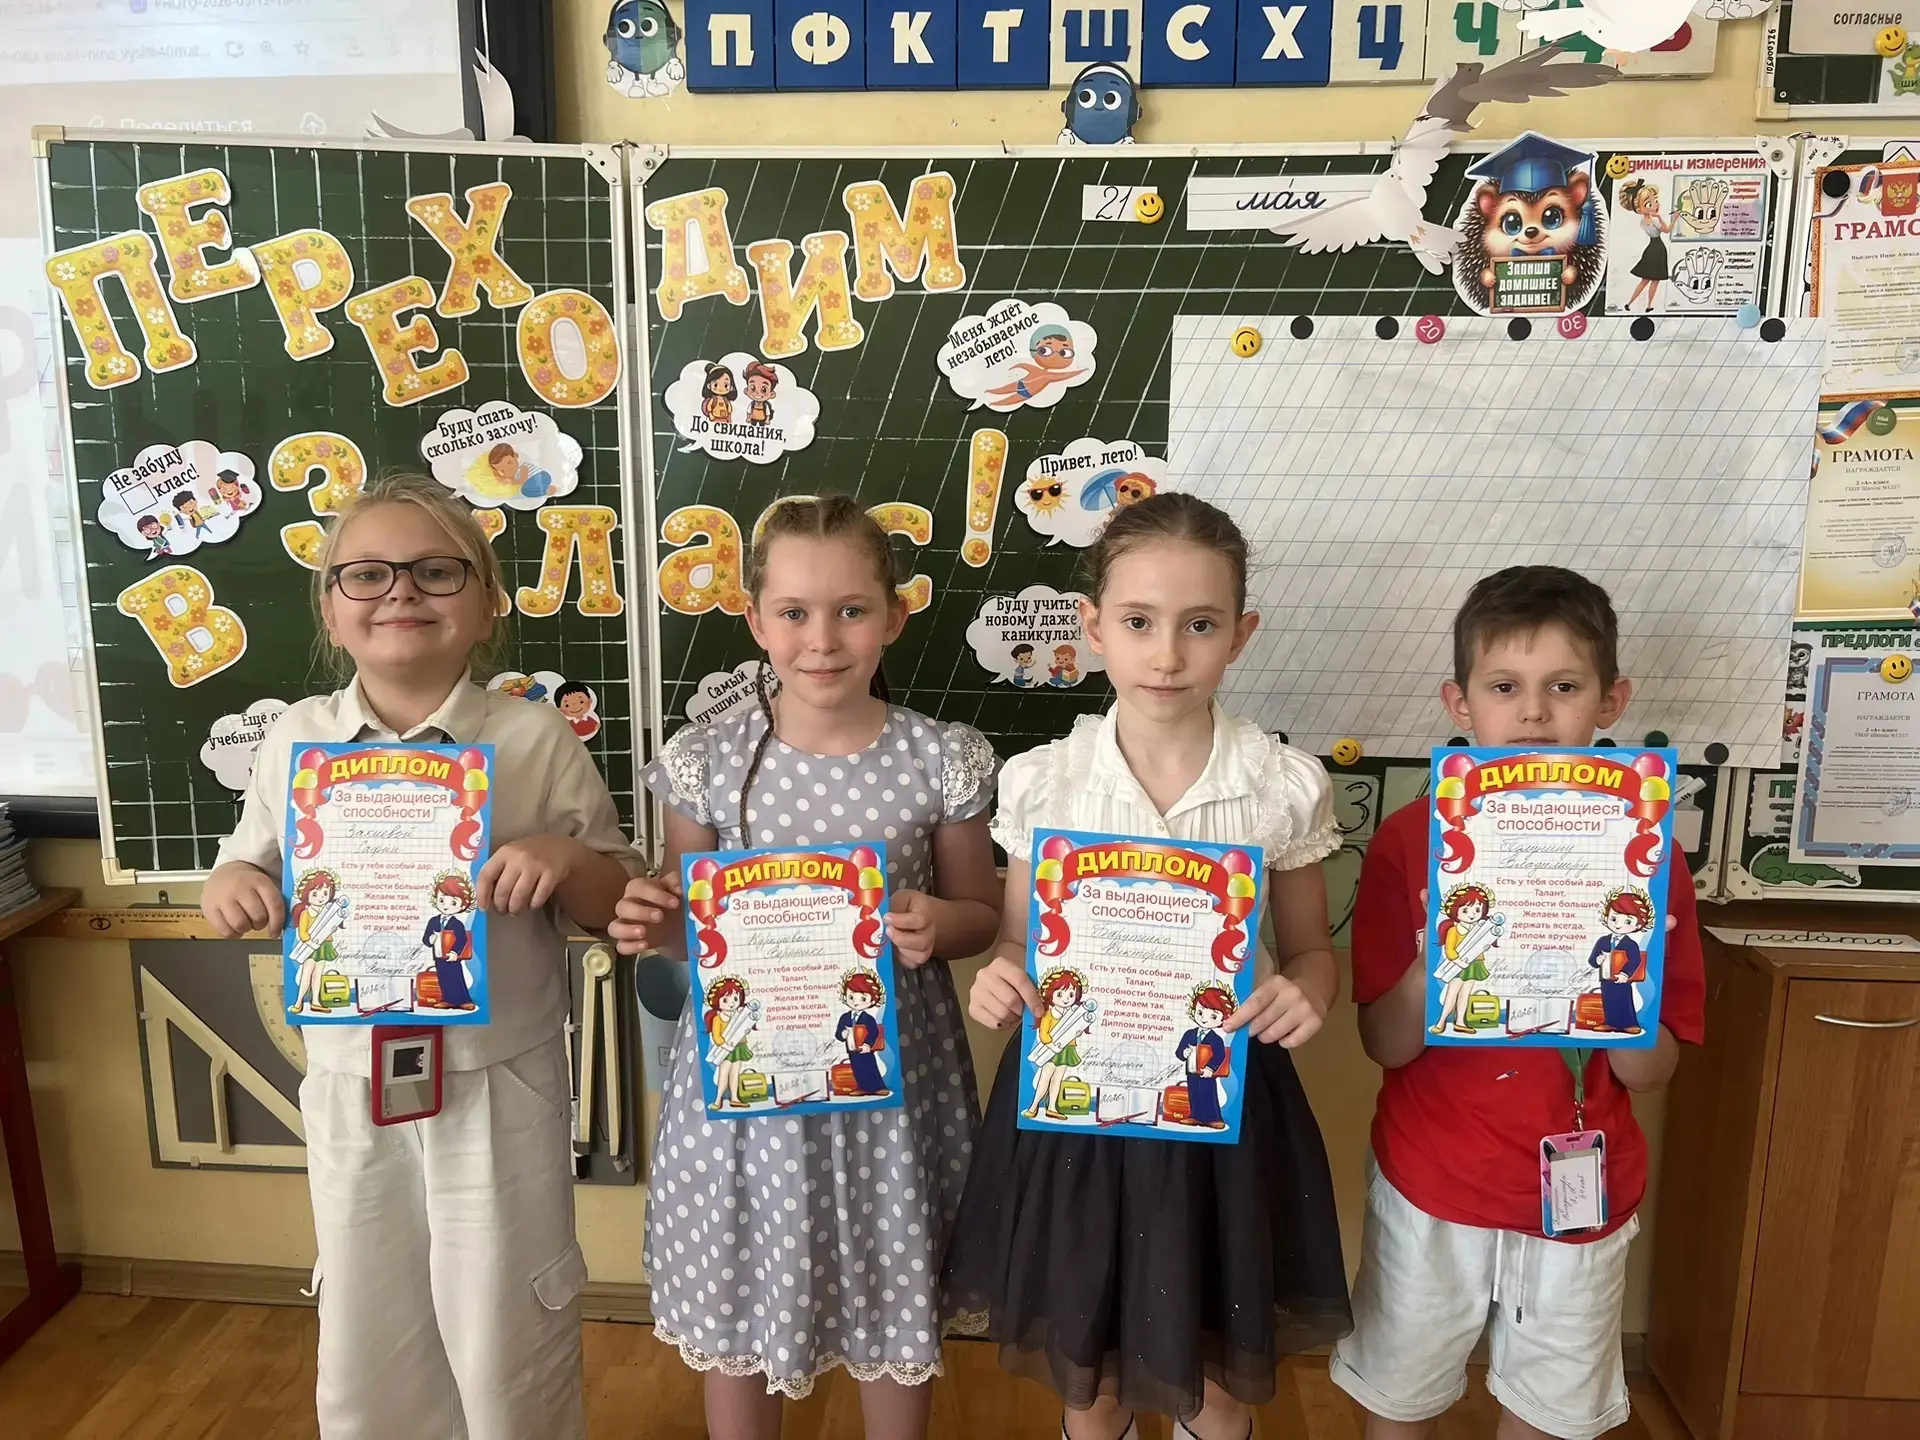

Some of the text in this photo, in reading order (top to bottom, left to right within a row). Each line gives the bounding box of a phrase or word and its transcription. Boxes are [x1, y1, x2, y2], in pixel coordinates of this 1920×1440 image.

[1834, 12, 1902, 25] согласные
[707, 14, 754, 66] П
[791, 12, 850, 65] Ф
[890, 11, 933, 64] К
[982, 9, 1023, 63] Т
[1062, 10, 1131, 62] Ш
[1165, 5, 1212, 61] С
[1260, 4, 1305, 60] Х
[1356, 4, 1404, 70] Ц
[1453, 3, 1500, 56] Ч
[1627, 157, 1767, 173] диницы измерения
[1095, 185, 1133, 220] 21
[1499, 278, 1558, 291] ДОМАШНЕЕ
[1500, 293, 1550, 306] ЗАДАНИЕ!
[948, 302, 1023, 349] Меня ждёт
[1419, 319, 1440, 340] 20
[1561, 315, 1582, 332] 30
[947, 312, 1040, 370] незабываемое
[984, 342, 1018, 369] лето!
[438, 406, 514, 438] Буду спать
[690, 415, 787, 443] До свидания,
[427, 414, 538, 458] сколько захочу!
[710, 438, 765, 456] школа!
[1040, 444, 1138, 477] Привет, лето!
[1832, 448, 1914, 463] ГРАМОТА
[109, 448, 183, 492] Не забуду
[153, 463, 200, 497] класс!
[996, 596, 1030, 614] Буду
[117, 565, 247, 688] В
[985, 614, 1077, 630] новому даже
[1001, 627, 1082, 643] каникулах!
[1821, 634, 1912, 650] ПРЕДЛОГИ
[707, 669, 748, 699] Самый
[695, 667, 778, 725] лучший клсс!
[1857, 691, 1915, 701] ГРАМОТА
[241, 712, 267, 728] Ещё
[208, 728, 266, 750] учебный
[330, 756, 451, 782] ДИПЛОМ
[1479, 762, 1624, 791] ДИПЛОМ
[335, 790, 447, 804] За выдающиеся
[344, 806, 430, 818] способности
[1486, 800, 1620, 816] За выдающиеся
[1497, 818, 1600, 831] способности
[1077, 850, 1212, 884] ДИПЛОМ
[724, 860, 844, 891] ДИПЛОМ
[1496, 877, 1516, 886] Есть
[1526, 878, 1547, 886] тебя
[1549, 877, 1583, 886] особый
[732, 895, 844, 910] За выдающиеся
[1082, 885, 1208, 908] За выдающиеся
[1497, 899, 1556, 908] способности
[743, 910, 830, 925] способности
[1092, 903, 1190, 924] способности
[1522, 911, 1558, 919] Желаем
[1512, 922, 1550, 930] держать
[1509, 931, 1587, 941] Диплом вручаем
[1532, 943, 1556, 951] души
[1090, 962, 1108, 972] Есть
[1118, 966, 1137, 974] тебя
[1139, 968, 1172, 978] особый
[1090, 986, 1146, 997] способности
[1114, 998, 1148, 1009] Желаем
[1103, 1009, 1140, 1019] держать
[1101, 1019, 1174, 1032] Диплом вручаем
[1122, 1032, 1146, 1041] души
